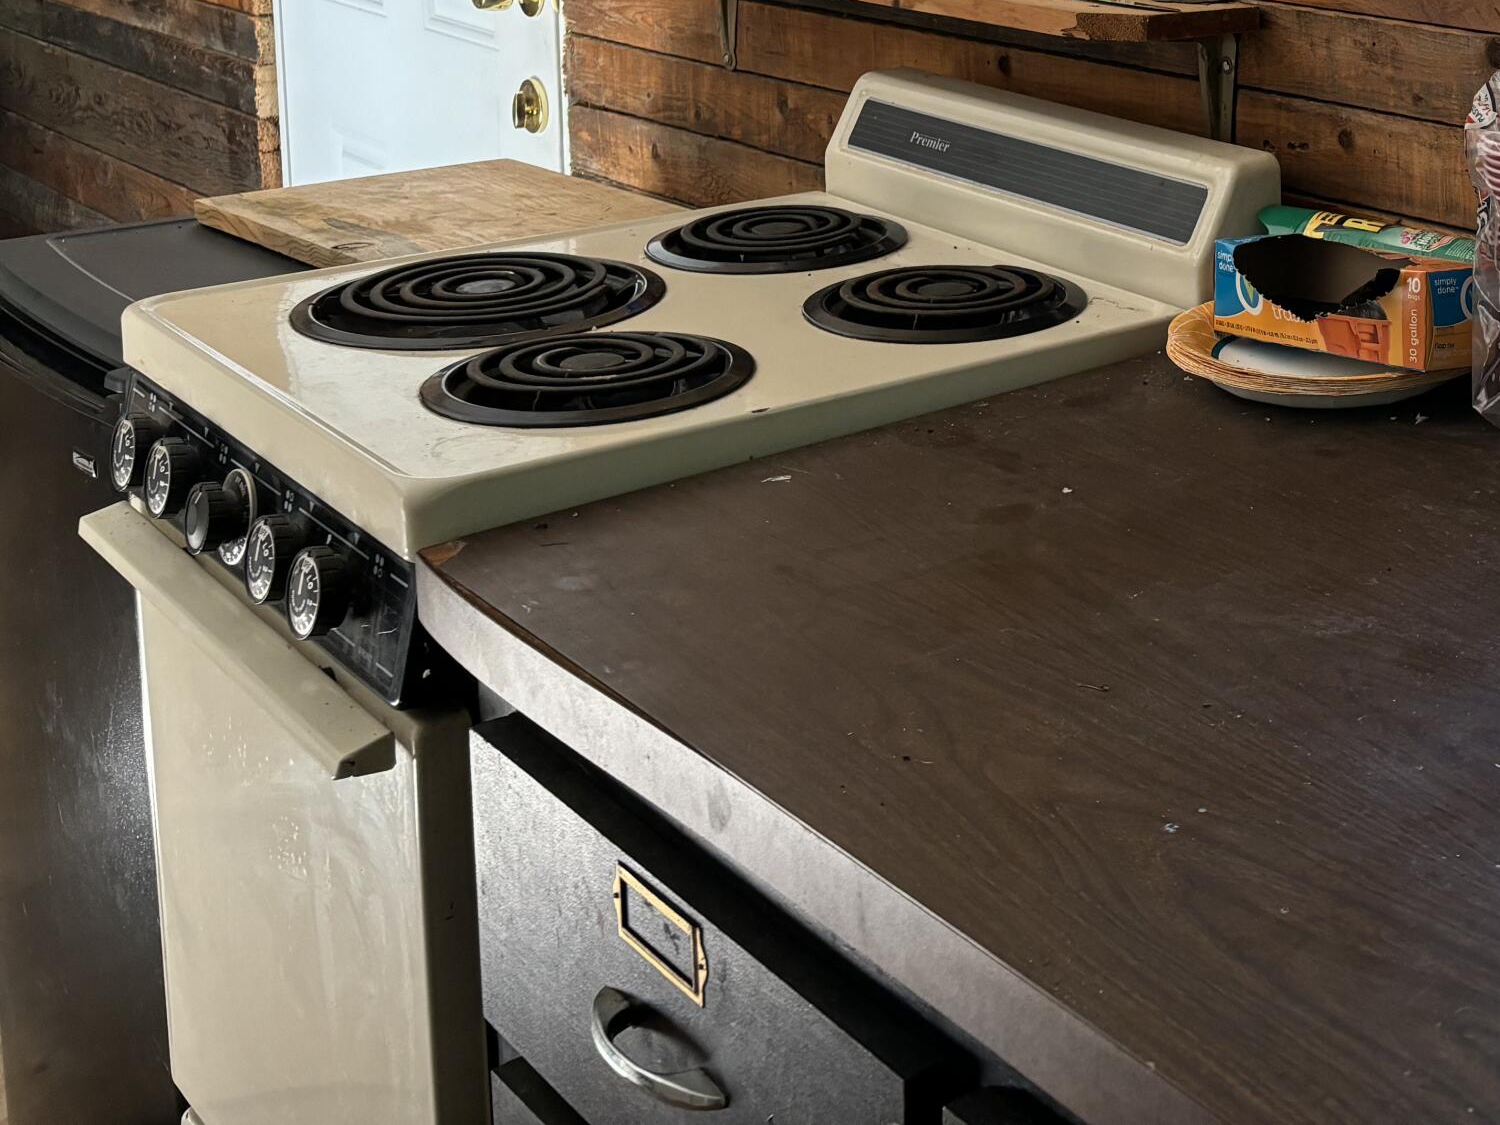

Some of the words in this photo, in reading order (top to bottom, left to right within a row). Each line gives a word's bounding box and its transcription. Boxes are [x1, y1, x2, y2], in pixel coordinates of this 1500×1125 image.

[910, 131, 950, 152] Premier
[1217, 251, 1235, 265] simp
[1406, 277, 1421, 293] 10
[1434, 277, 1457, 288] simply
[1408, 309, 1419, 346] gallon
[1409, 348, 1418, 363] 30
